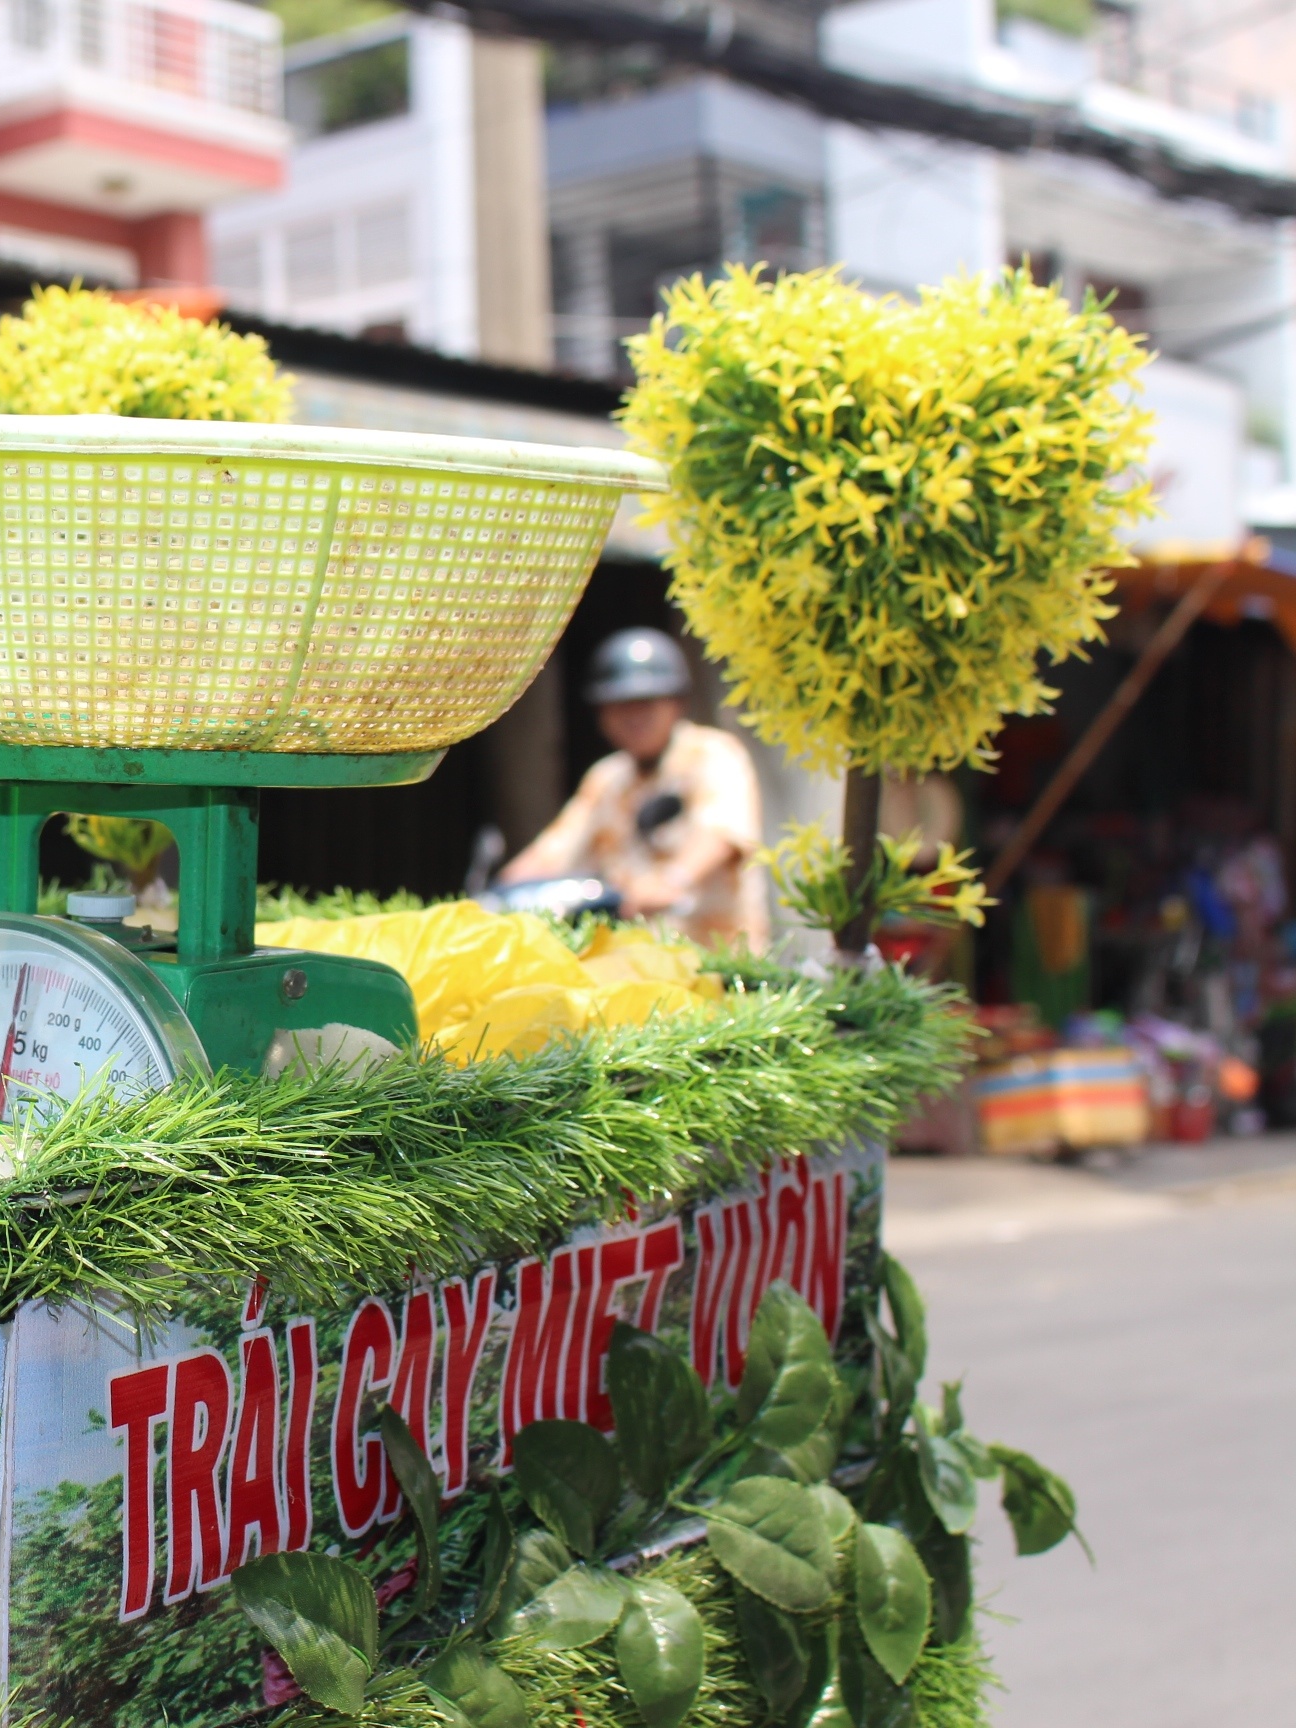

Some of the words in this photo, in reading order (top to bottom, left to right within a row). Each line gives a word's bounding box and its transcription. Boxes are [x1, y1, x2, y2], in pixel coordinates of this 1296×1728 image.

[20, 1010, 28, 1022] 0
[47, 1012, 70, 1028] 200
[74, 1018, 82, 1032] g
[13, 1031, 27, 1055] 5
[31, 1040, 49, 1063] kg
[78, 1036, 102, 1051] 400
[109, 1275, 315, 1615] TRÁI
